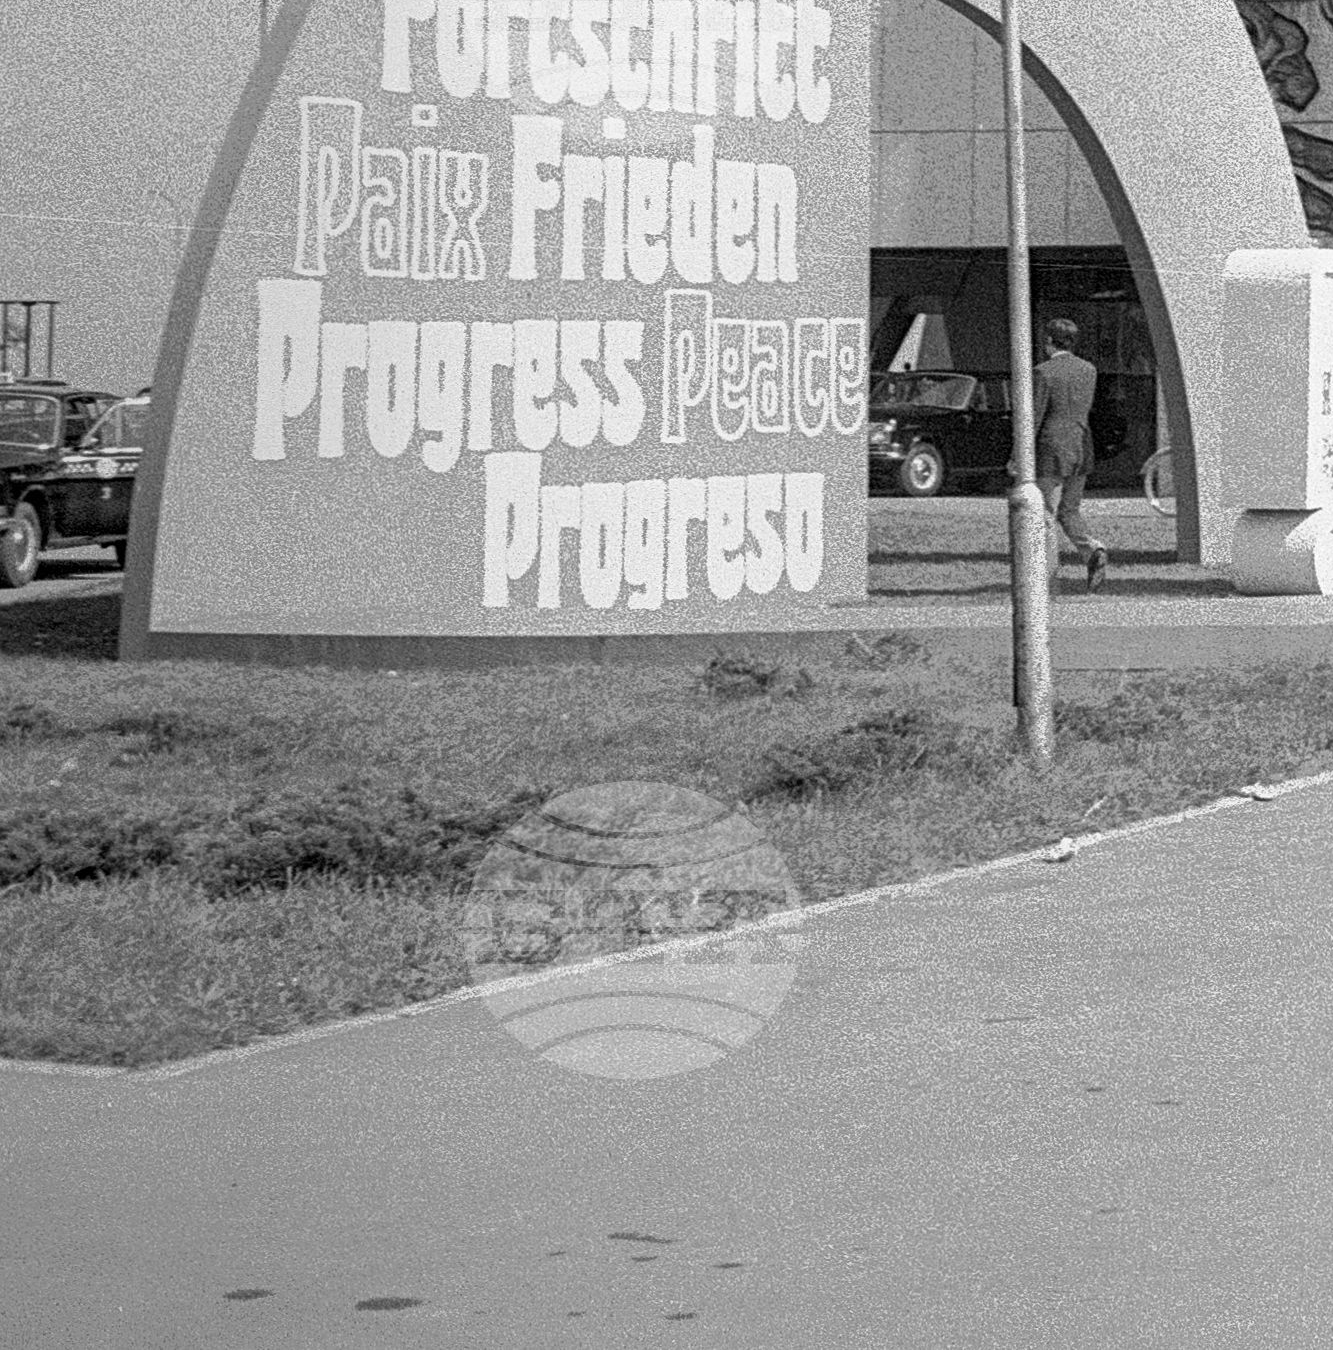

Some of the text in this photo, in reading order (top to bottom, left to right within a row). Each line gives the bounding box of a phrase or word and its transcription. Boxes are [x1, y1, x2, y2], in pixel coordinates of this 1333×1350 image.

[293, 96, 798, 284] Paix Frieden
[253, 279, 865, 472] Progress Peace
[482, 452, 824, 609] Progreso
